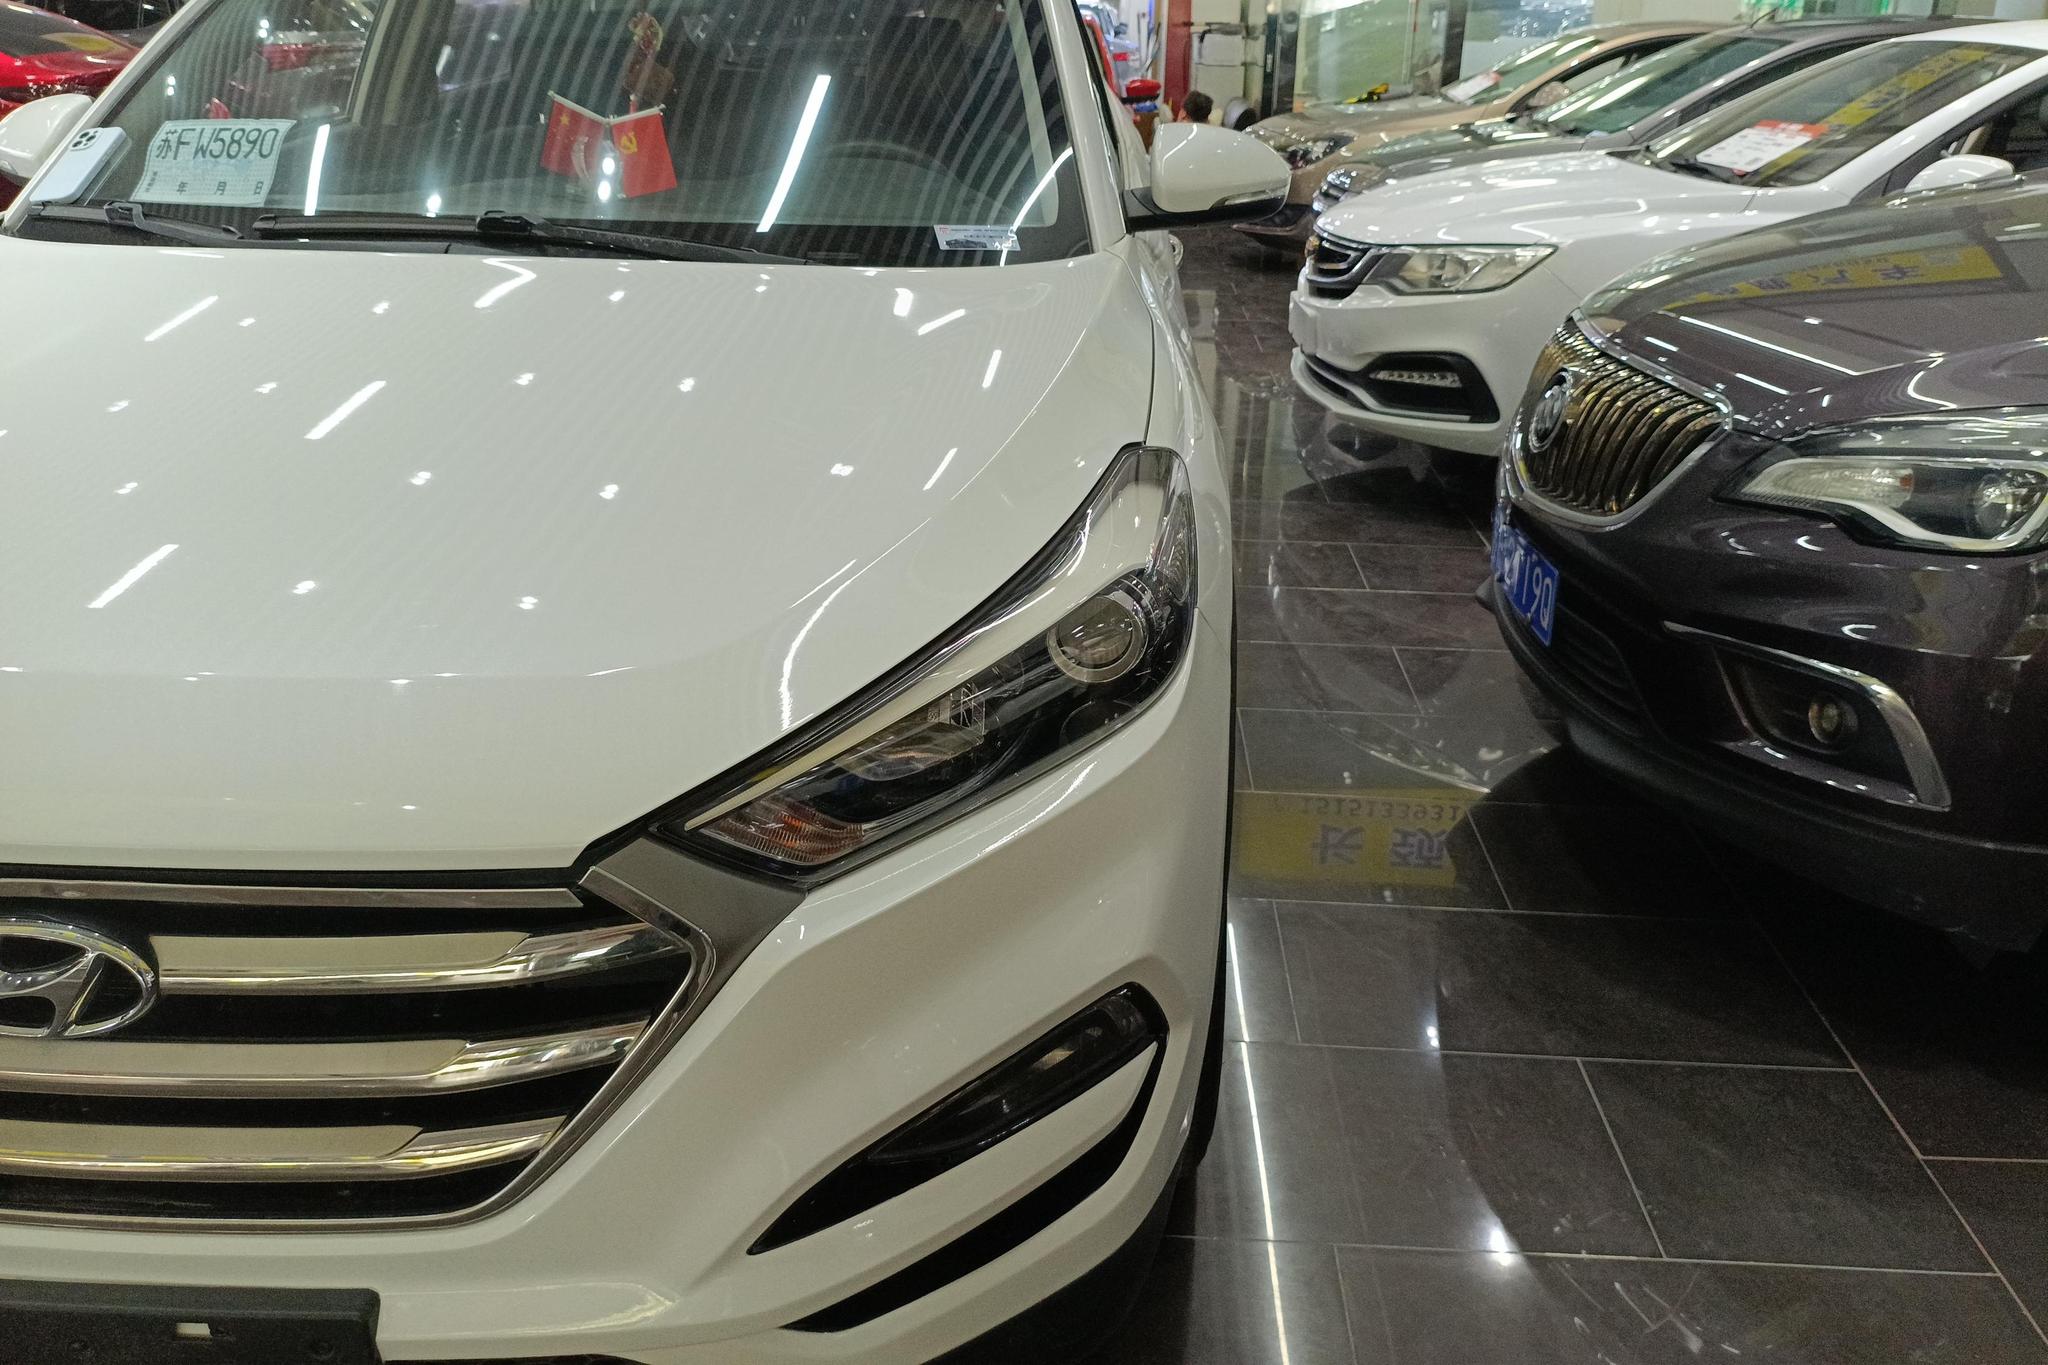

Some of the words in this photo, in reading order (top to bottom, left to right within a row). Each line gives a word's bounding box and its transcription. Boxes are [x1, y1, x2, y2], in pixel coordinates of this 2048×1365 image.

[156, 127, 279, 160] 苏FW5890
[177, 182, 188, 193] 年
[215, 182, 227, 195] 月
[254, 181, 264, 195] 日
